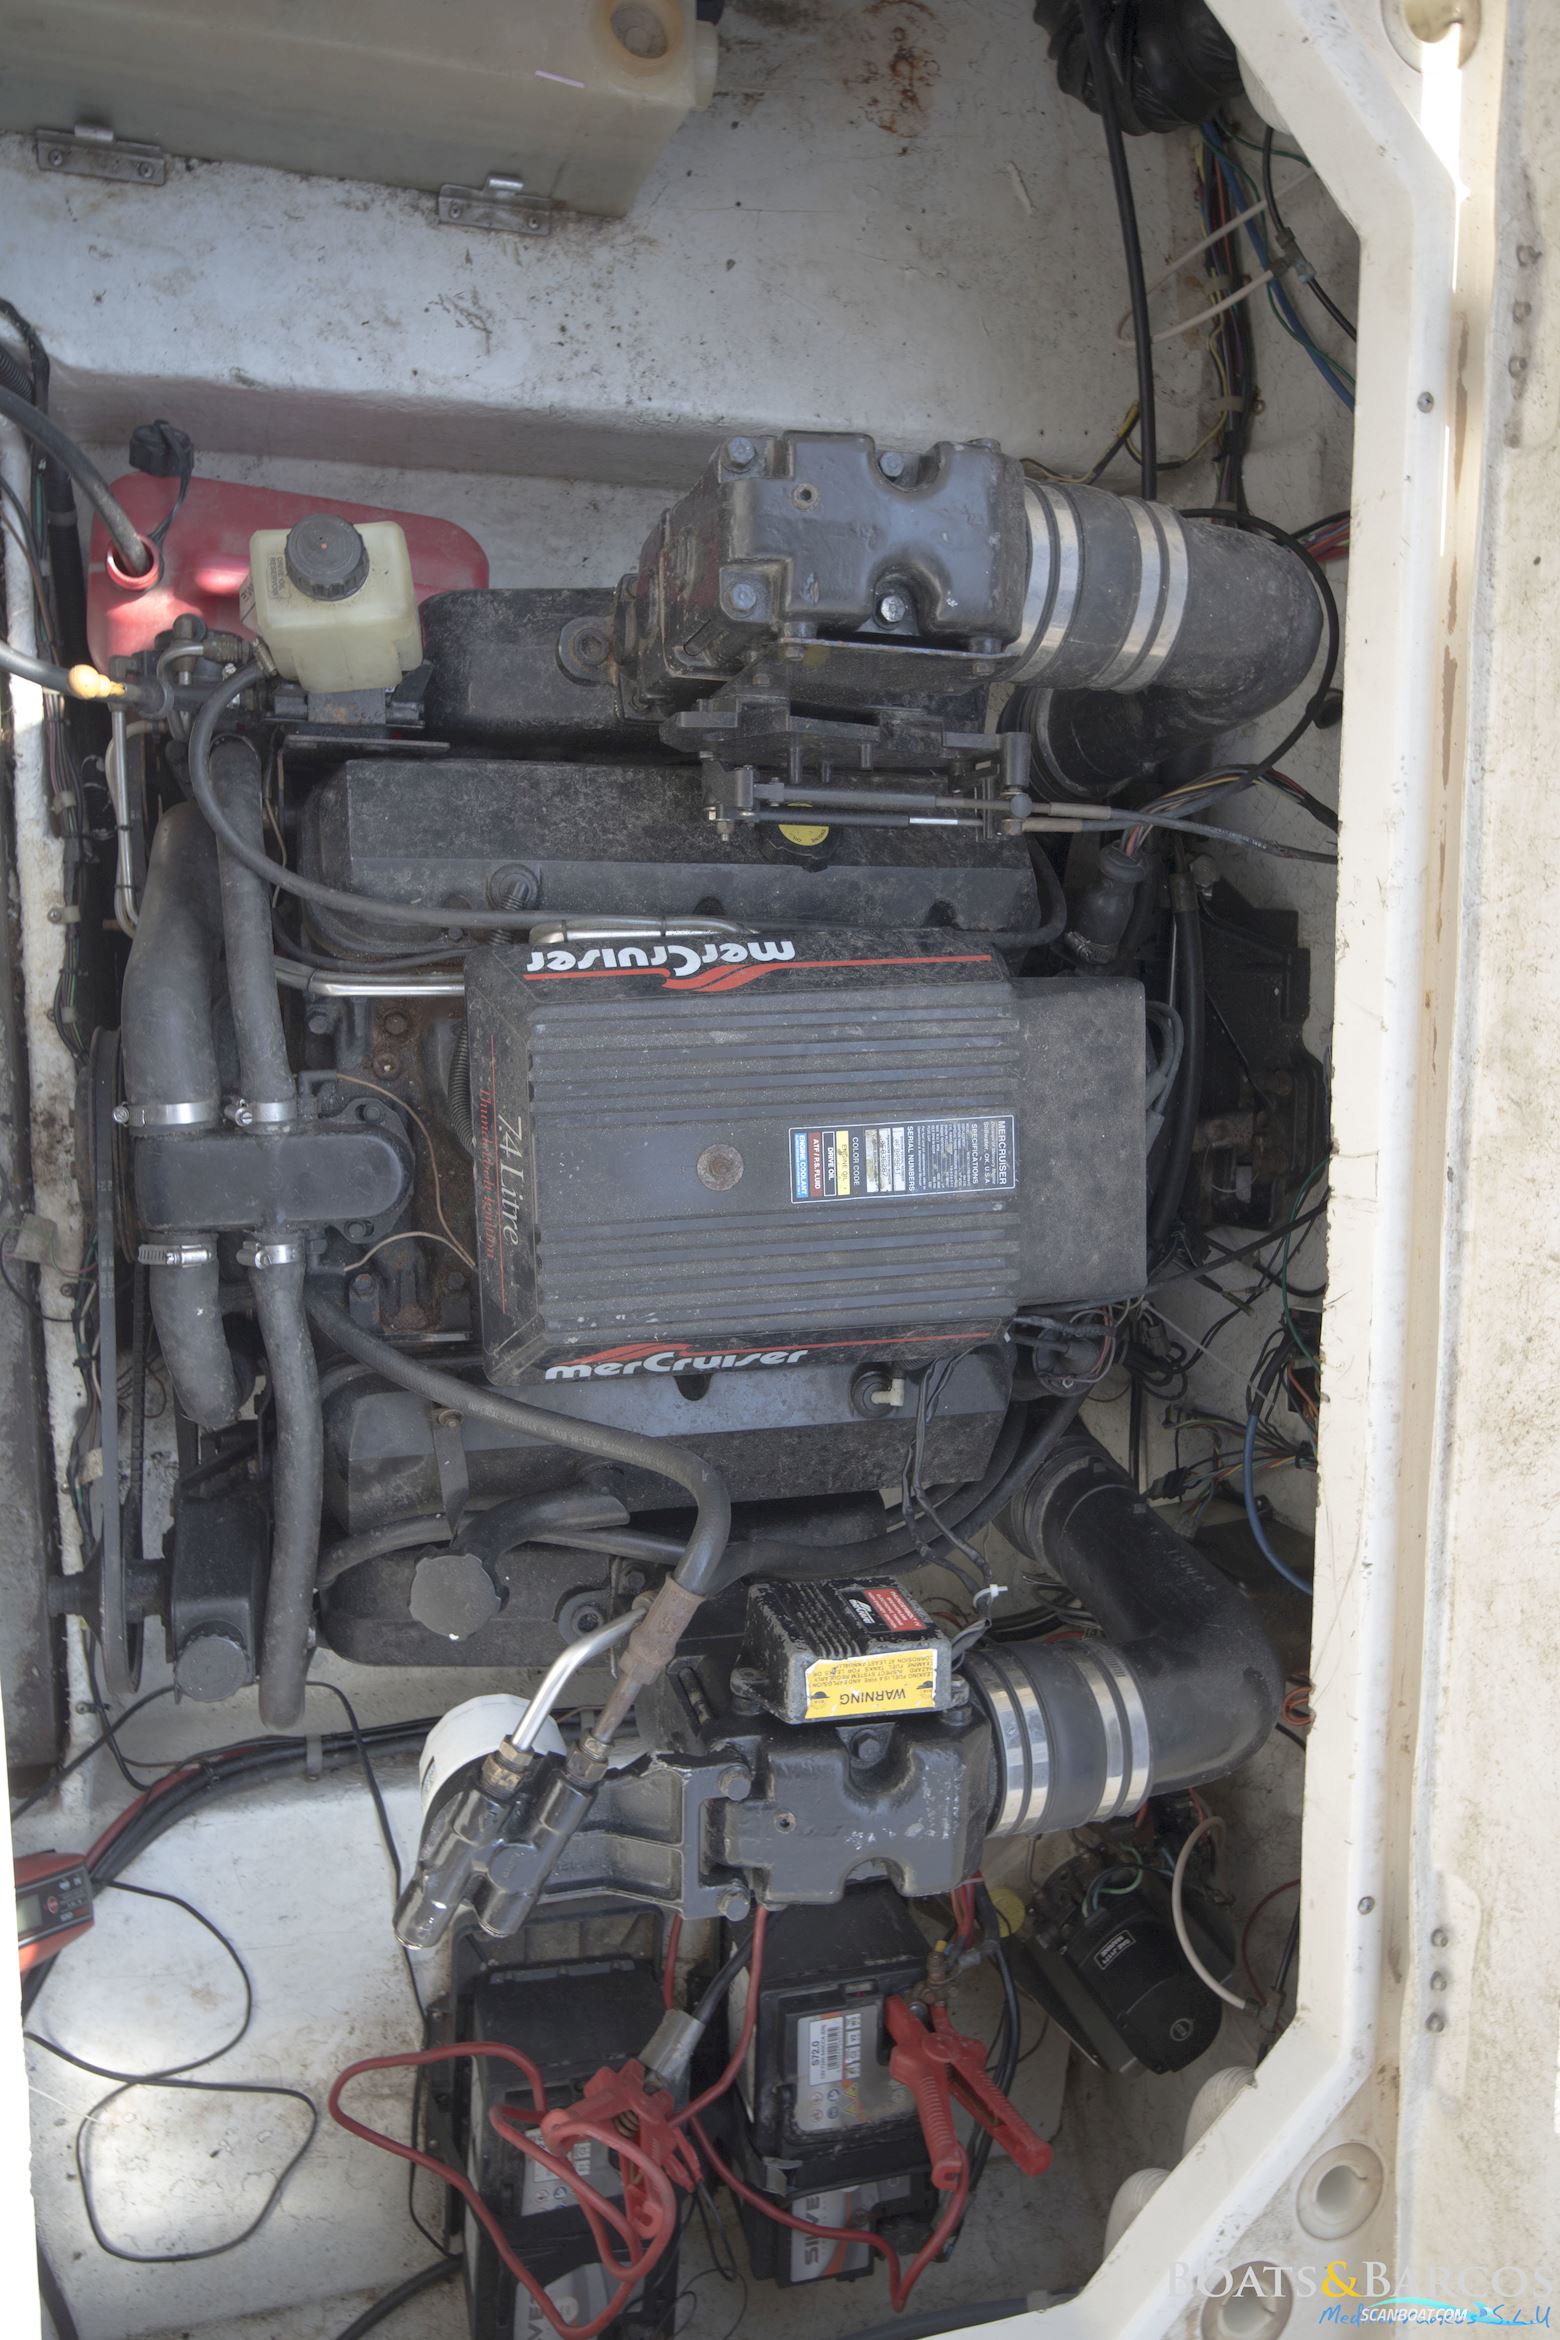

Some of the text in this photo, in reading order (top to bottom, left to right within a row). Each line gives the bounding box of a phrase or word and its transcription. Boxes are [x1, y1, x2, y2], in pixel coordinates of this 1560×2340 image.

[998, 1121, 1006, 1184] MERCRUISER
[498, 1114, 524, 1246] 7.4 Litre
[545, 1349, 808, 1382] merCruiser
[840, 1689, 906, 1704] WARNING
[811, 2040, 820, 2066] S72.0
